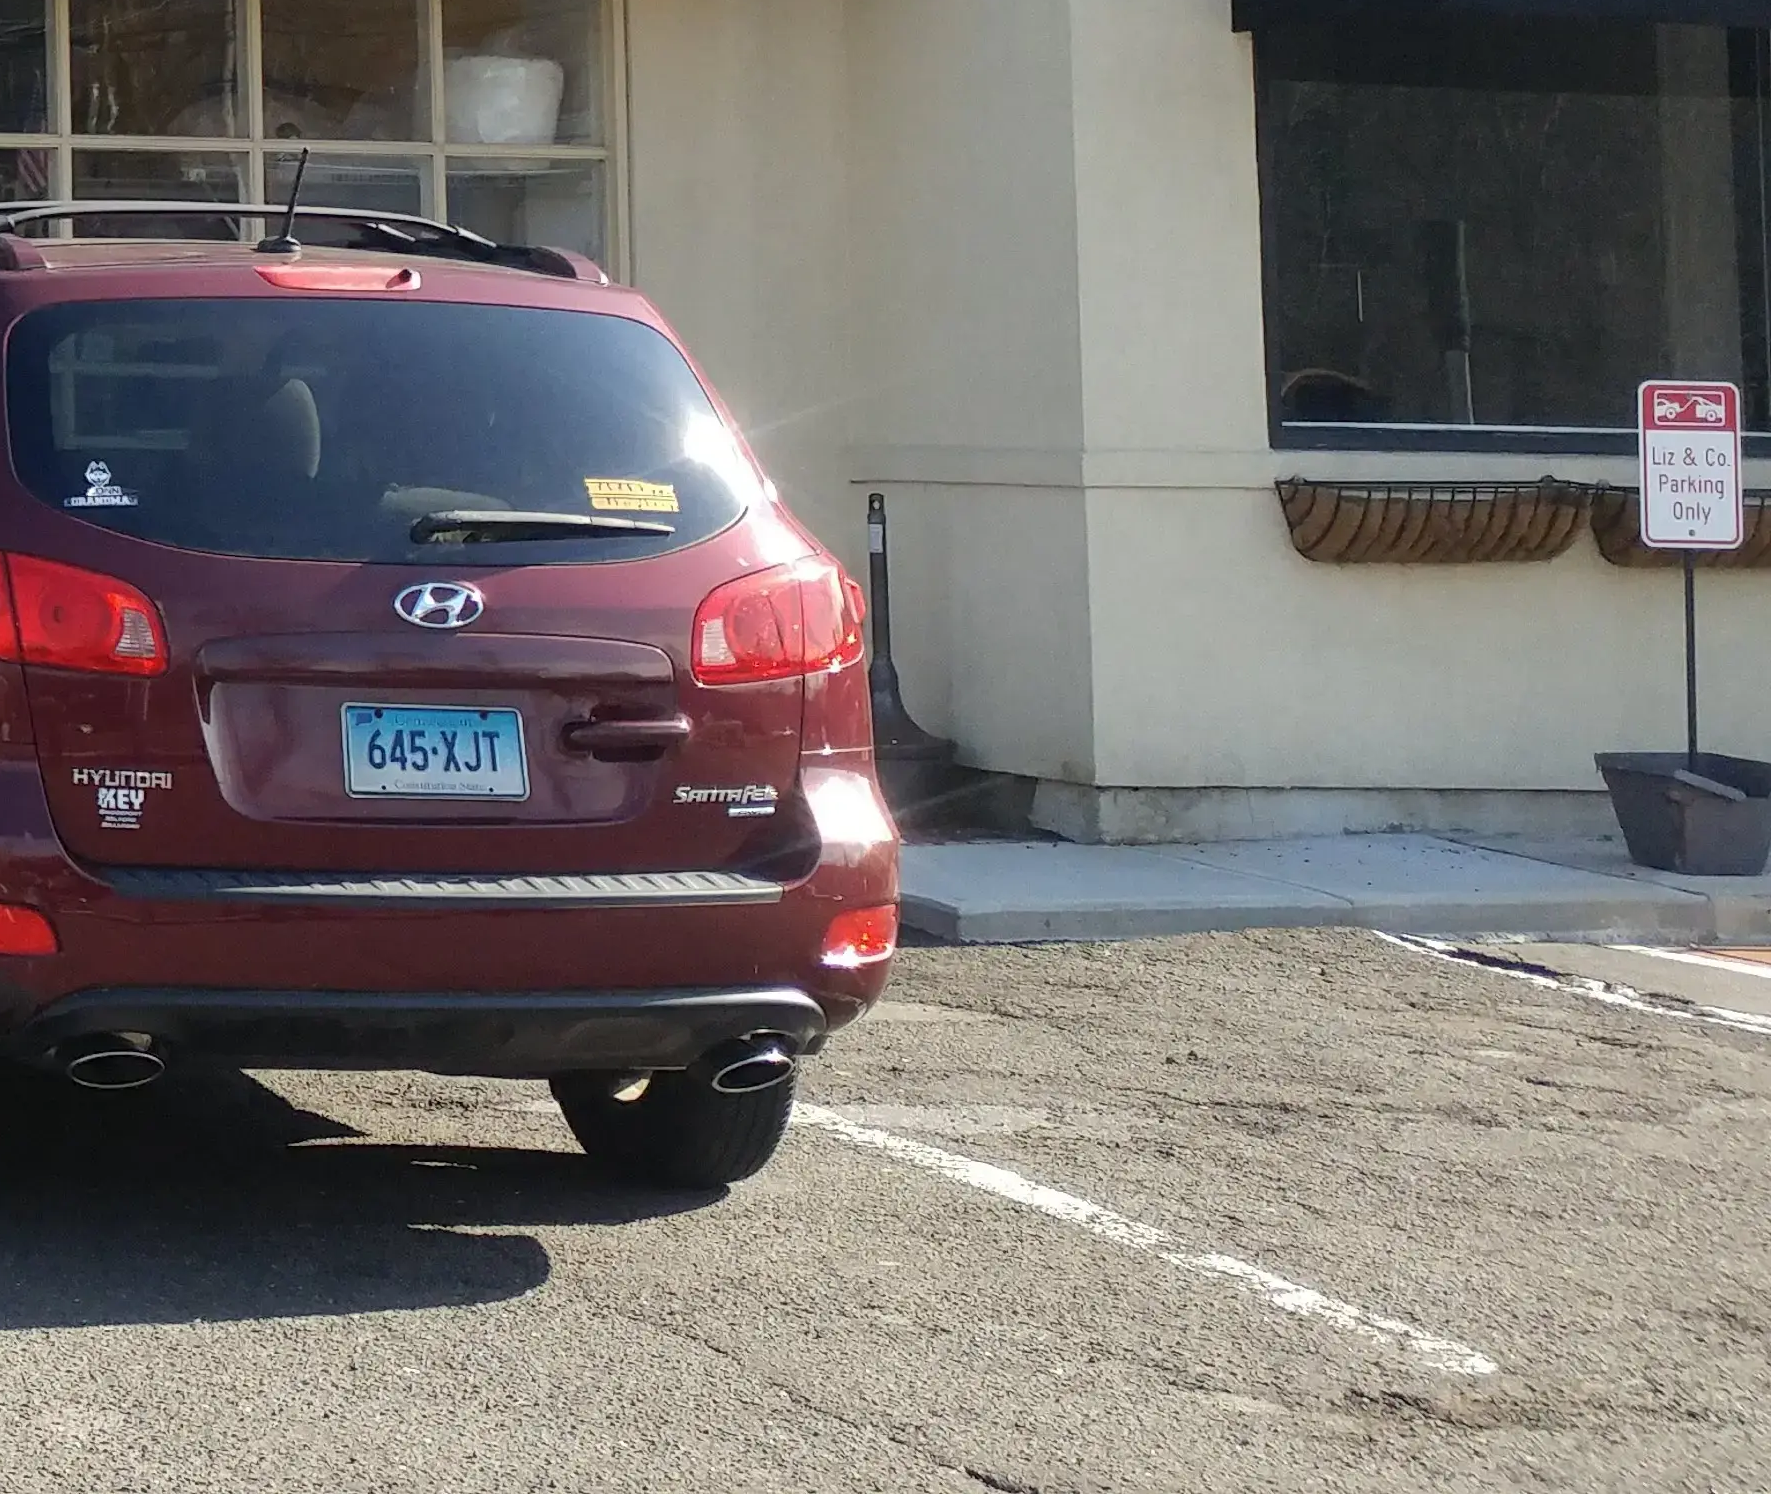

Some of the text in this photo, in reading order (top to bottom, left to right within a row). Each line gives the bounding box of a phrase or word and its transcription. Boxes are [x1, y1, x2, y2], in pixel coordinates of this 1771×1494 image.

[1652, 447, 1732, 467] Liz & Co.
[1659, 474, 1725, 499] Parking
[1672, 502, 1712, 525] Only
[72, 768, 173, 790] HYUNDAI
[98, 787, 145, 810] KEY
